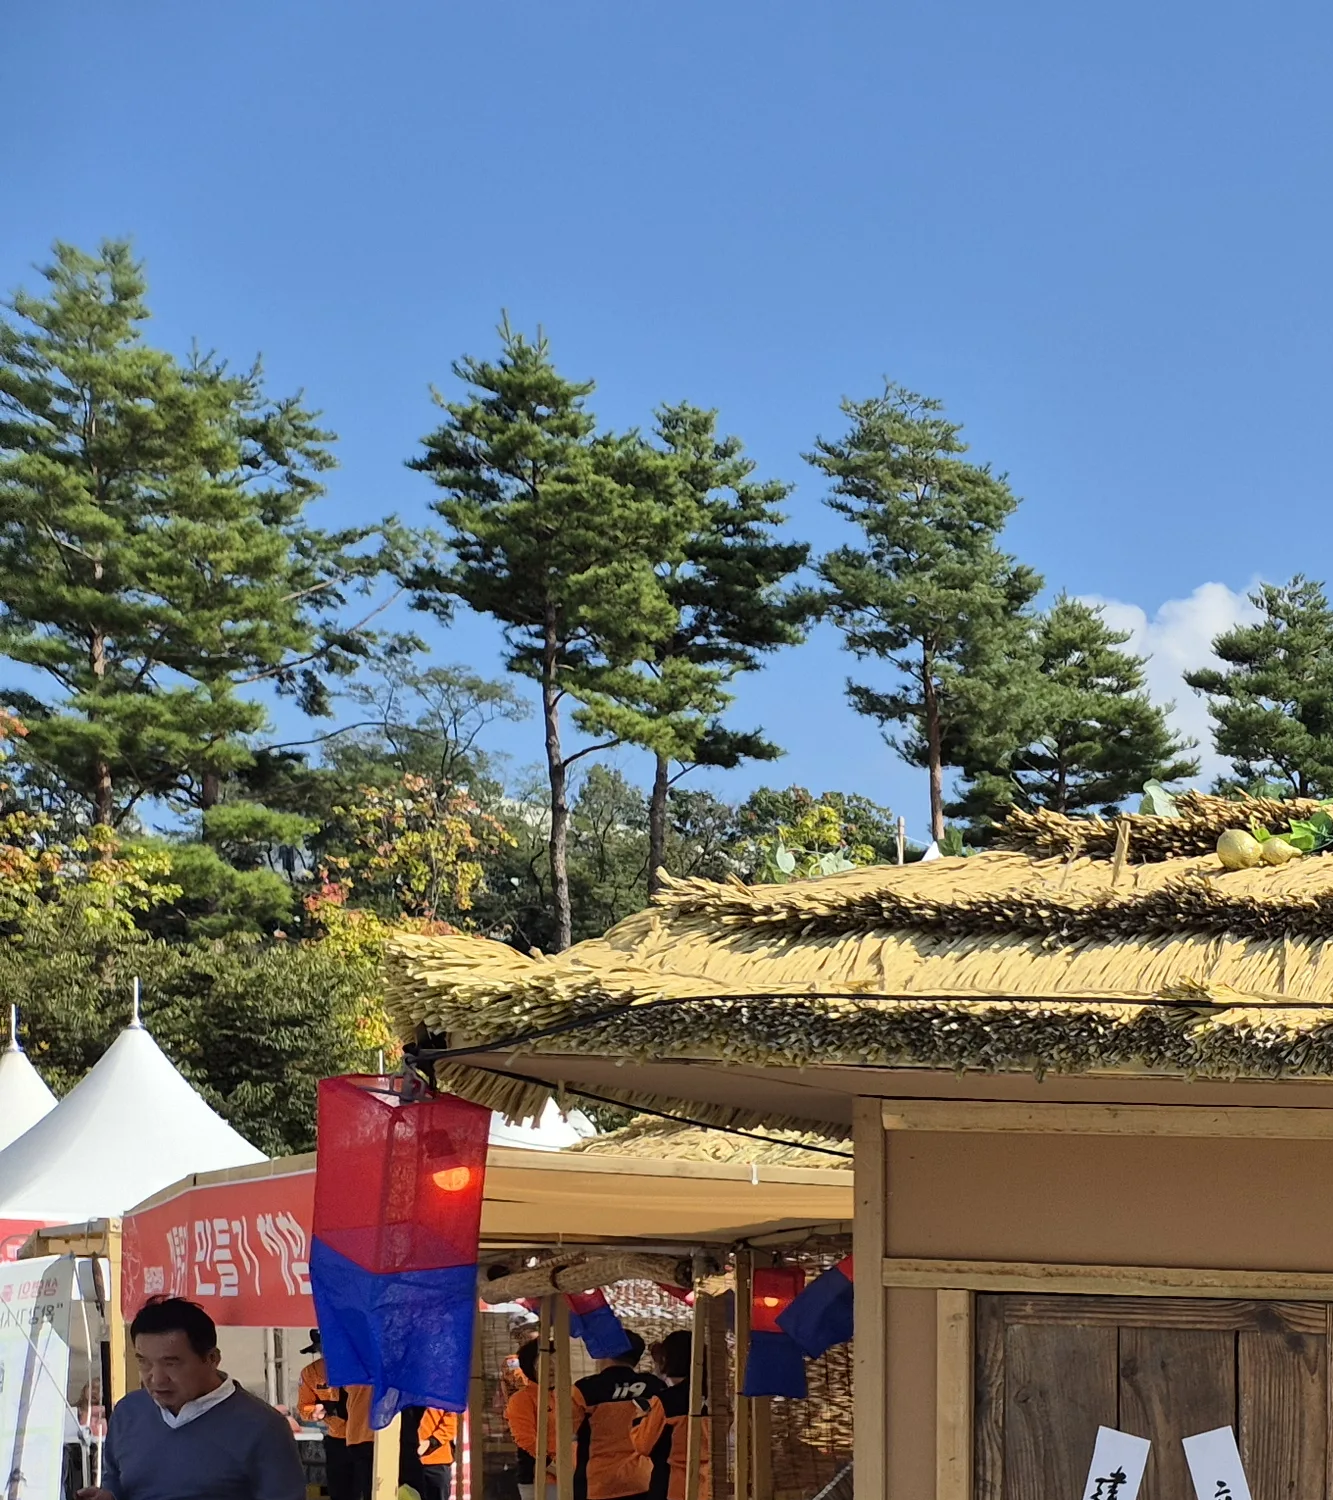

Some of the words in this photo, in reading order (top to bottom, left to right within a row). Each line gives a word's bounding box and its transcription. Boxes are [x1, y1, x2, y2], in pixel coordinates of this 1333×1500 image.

[195, 1216, 260, 1296] 만들기
[257, 1211, 313, 1296] 체험
[612, 1381, 647, 1399] 119
